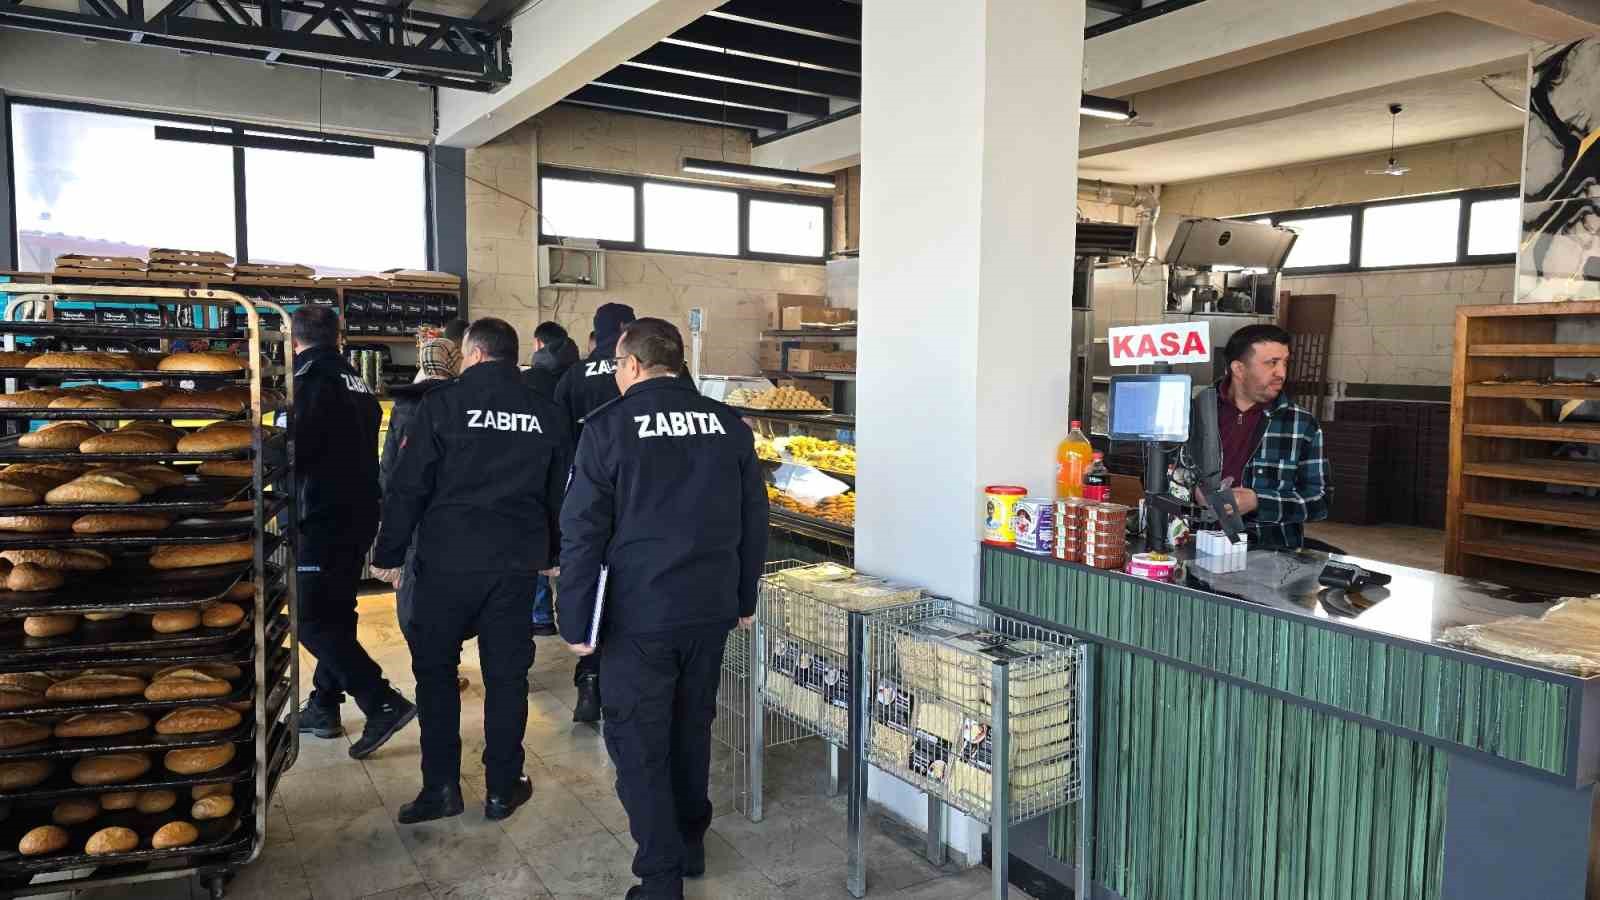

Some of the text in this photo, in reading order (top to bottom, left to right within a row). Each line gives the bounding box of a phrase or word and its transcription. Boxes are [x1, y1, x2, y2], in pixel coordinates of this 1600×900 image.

[1112, 331, 1207, 358] KASA
[466, 409, 543, 434] ZABITA
[634, 411, 727, 439] ZABITA
